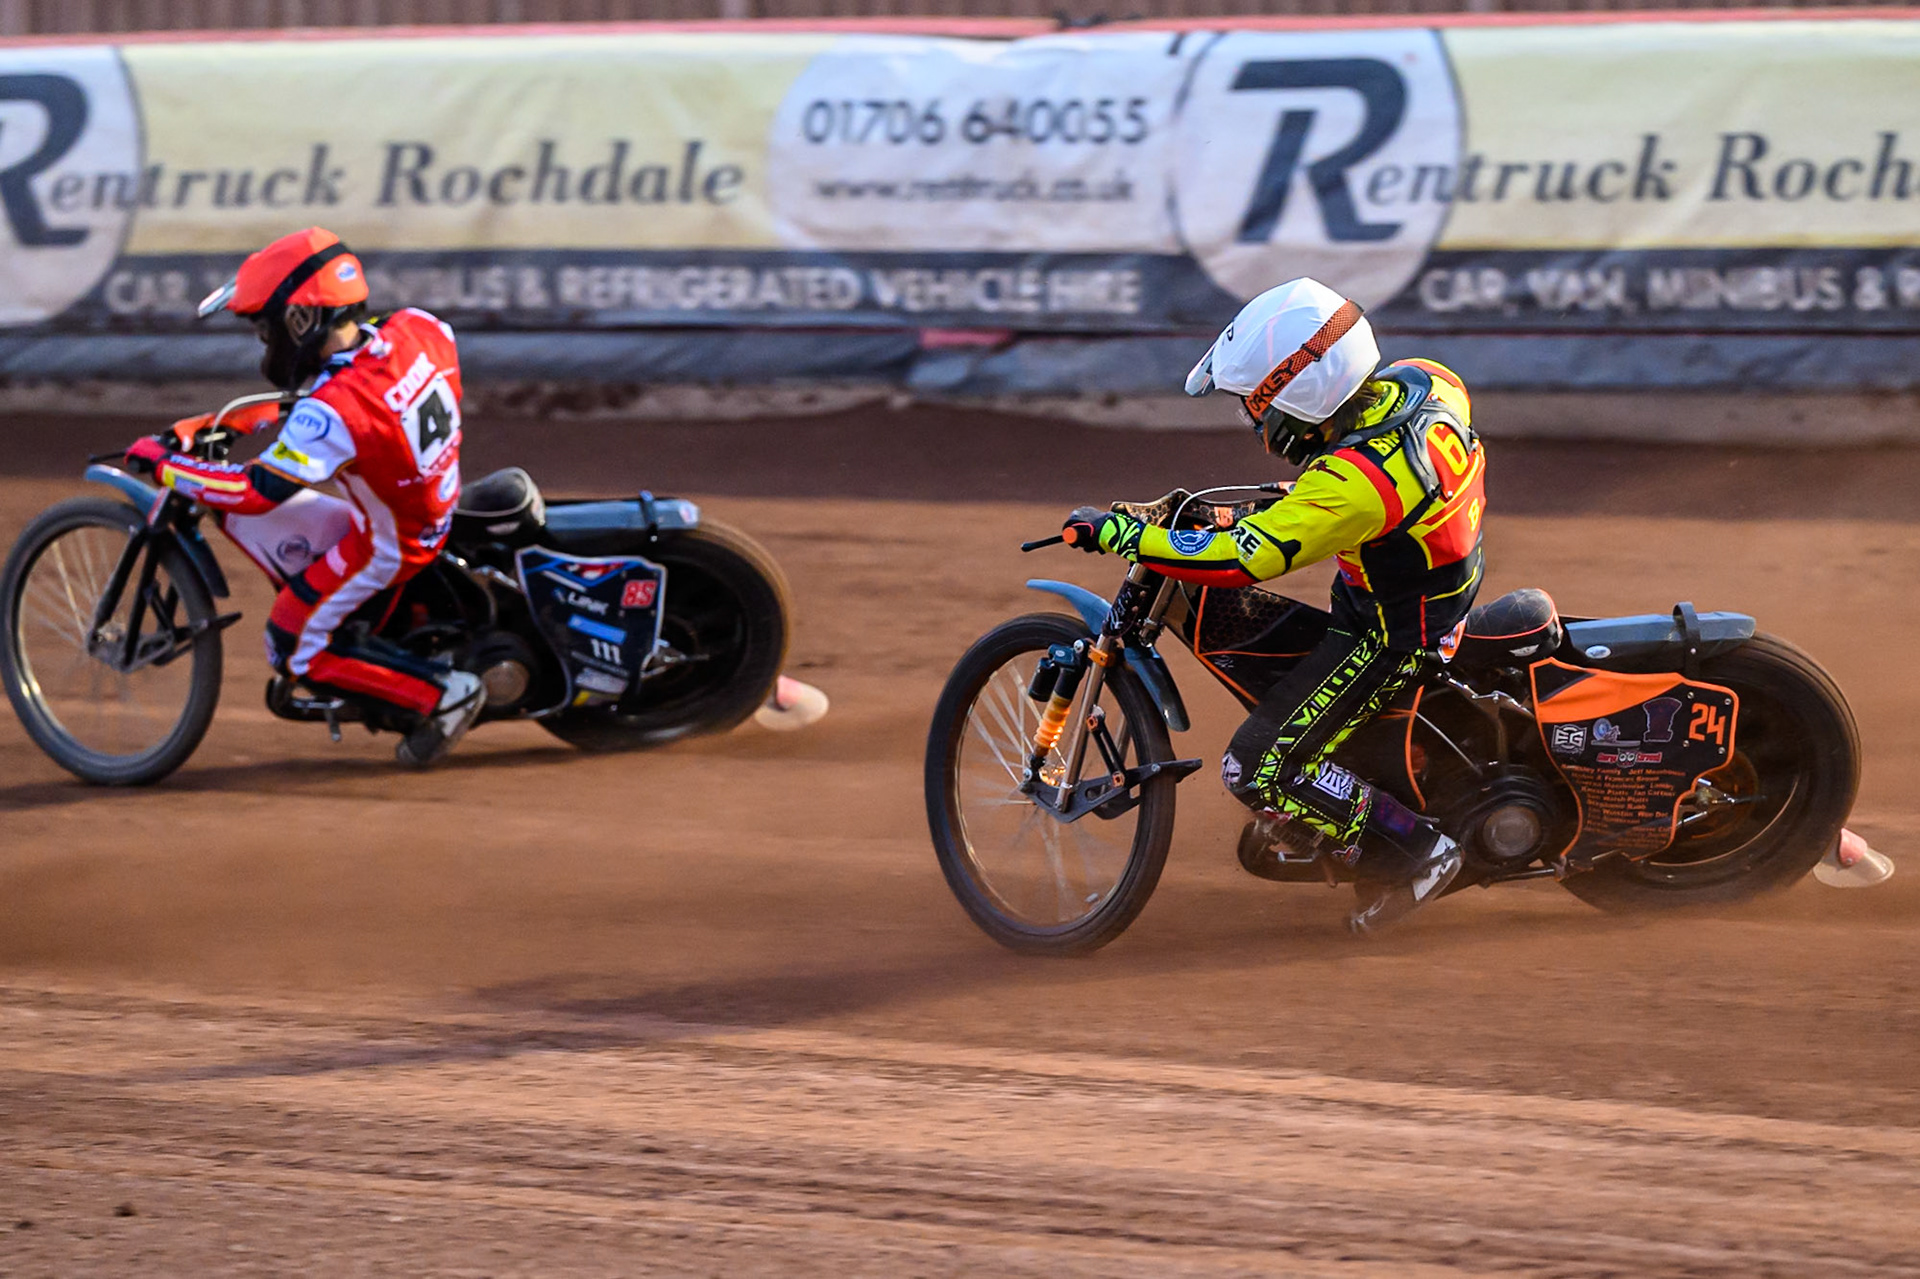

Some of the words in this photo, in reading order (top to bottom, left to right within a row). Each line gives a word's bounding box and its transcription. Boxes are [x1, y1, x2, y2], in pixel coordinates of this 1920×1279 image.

[804, 99, 945, 145] 01706
[961, 98, 1147, 145] 640055
[375, 140, 745, 206] Rochdale
[1230, 57, 1677, 243] Rentruck
[1707, 131, 1920, 202] Roch
[871, 269, 1040, 312] VEHICLE
[1248, 357, 1296, 414] OAKLEY
[417, 389, 453, 455] 4
[1427, 423, 1469, 476] 6
[1554, 728, 1584, 747] EG
[1688, 702, 1727, 746] 24
